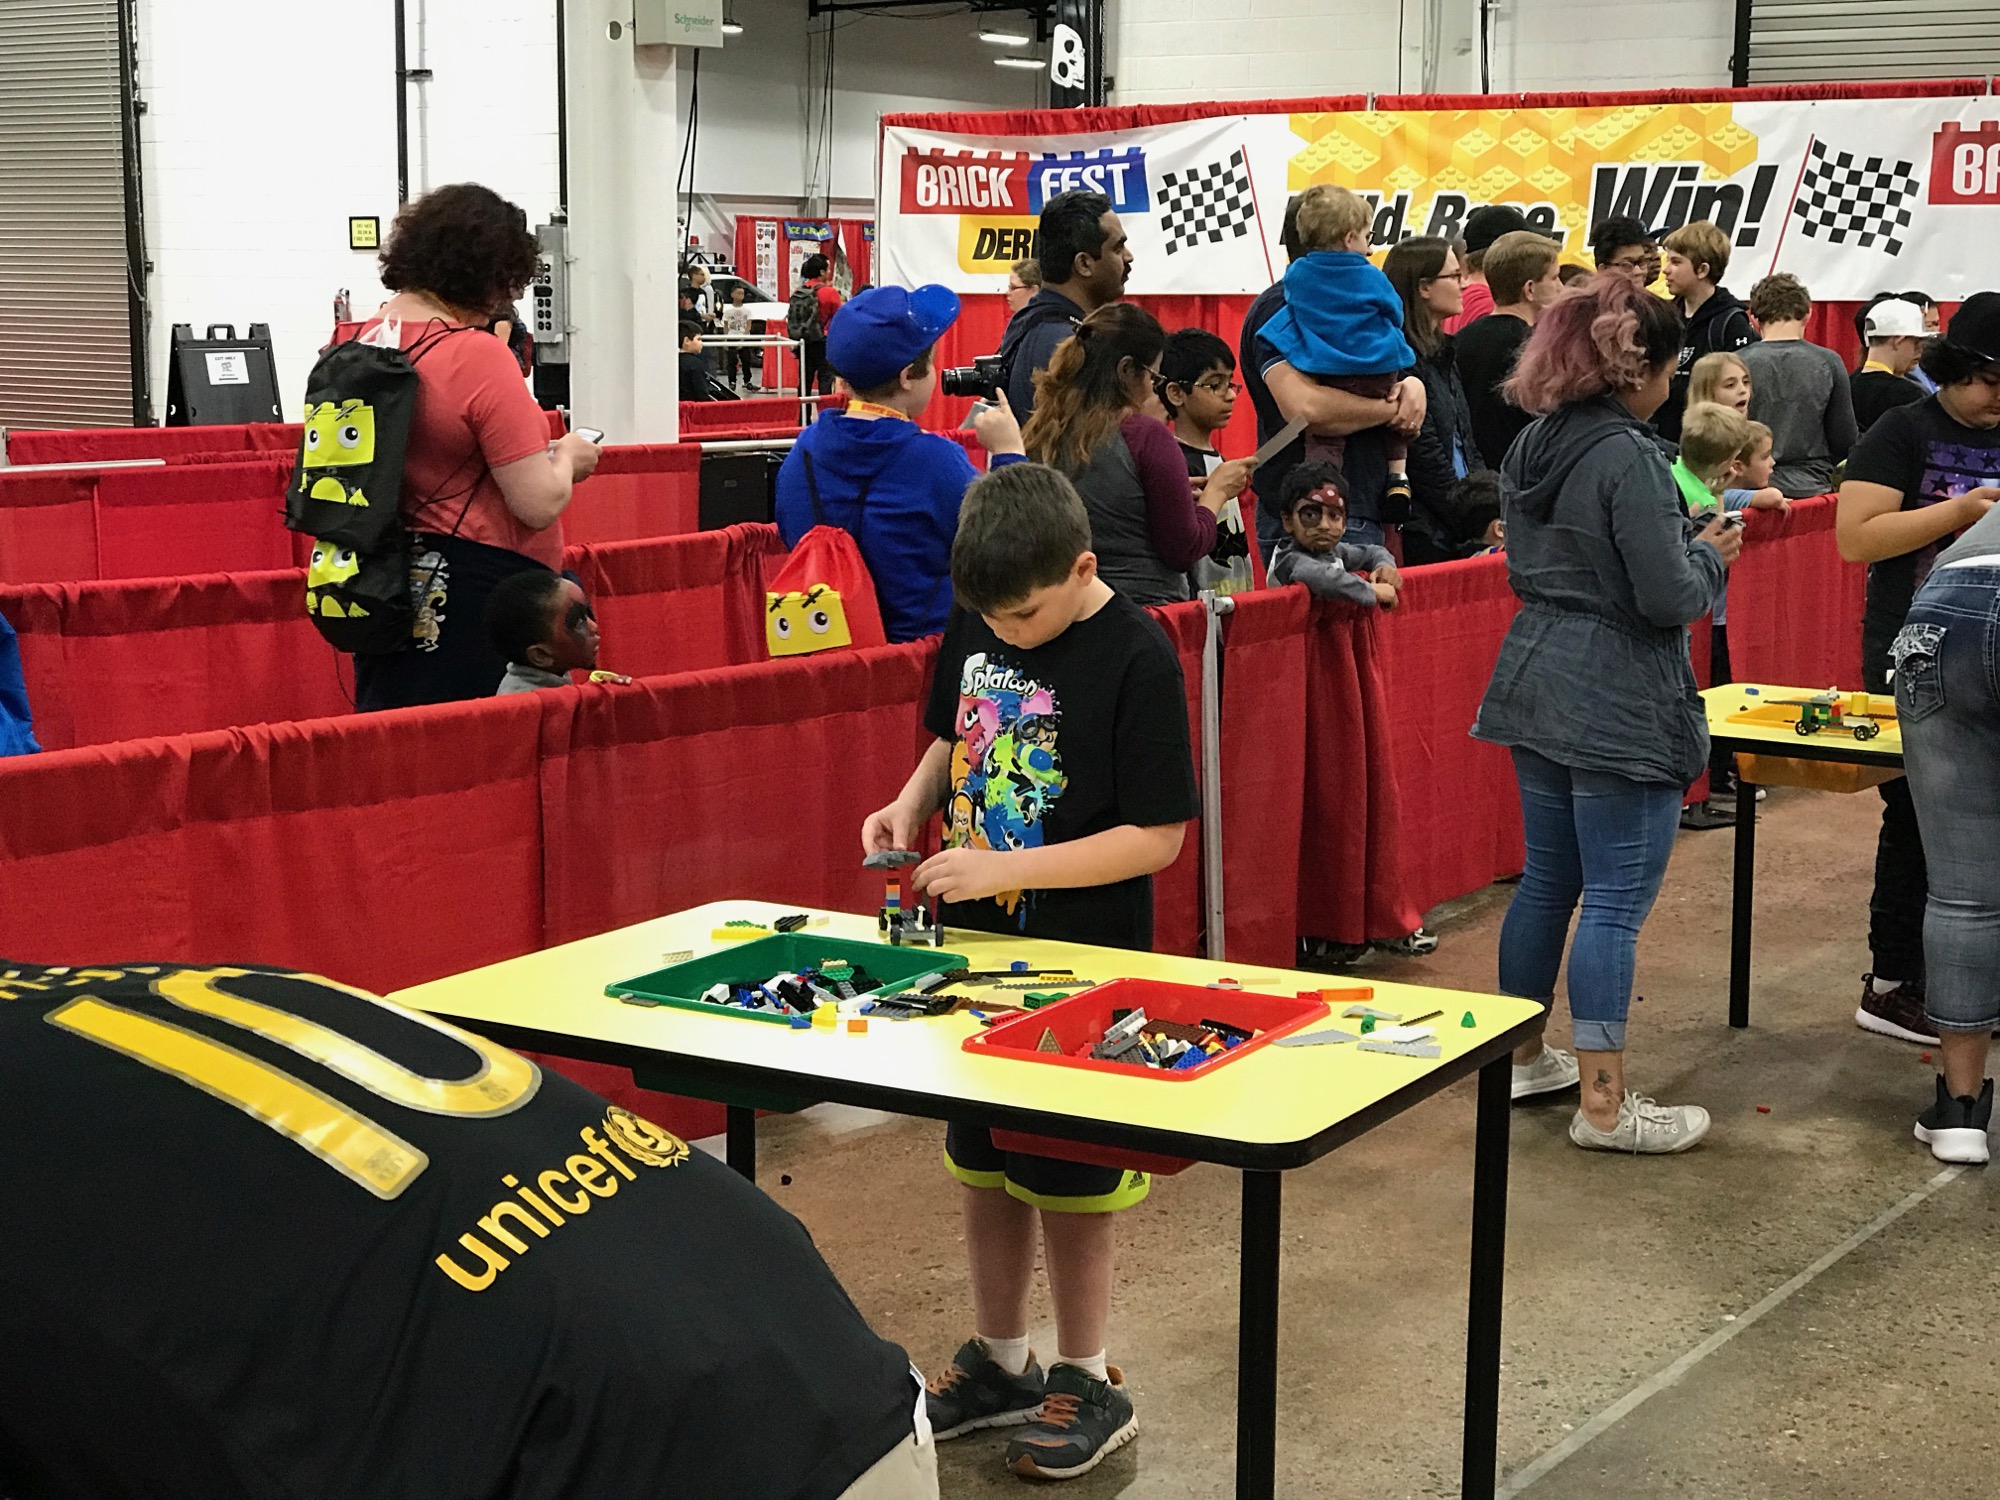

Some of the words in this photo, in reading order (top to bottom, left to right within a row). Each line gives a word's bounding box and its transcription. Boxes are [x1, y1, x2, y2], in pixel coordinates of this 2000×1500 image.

[674, 13, 714, 32] Schneider
[915, 164, 1015, 208] BRICK
[1040, 162, 1131, 205] FEST
[1425, 195, 1565, 244] Re.
[1588, 164, 1780, 248] Win!
[972, 227, 1041, 262] DER
[963, 652, 1038, 697] Splatoon
[42, 966, 542, 1201] 10
[435, 1126, 637, 1292] unicef
